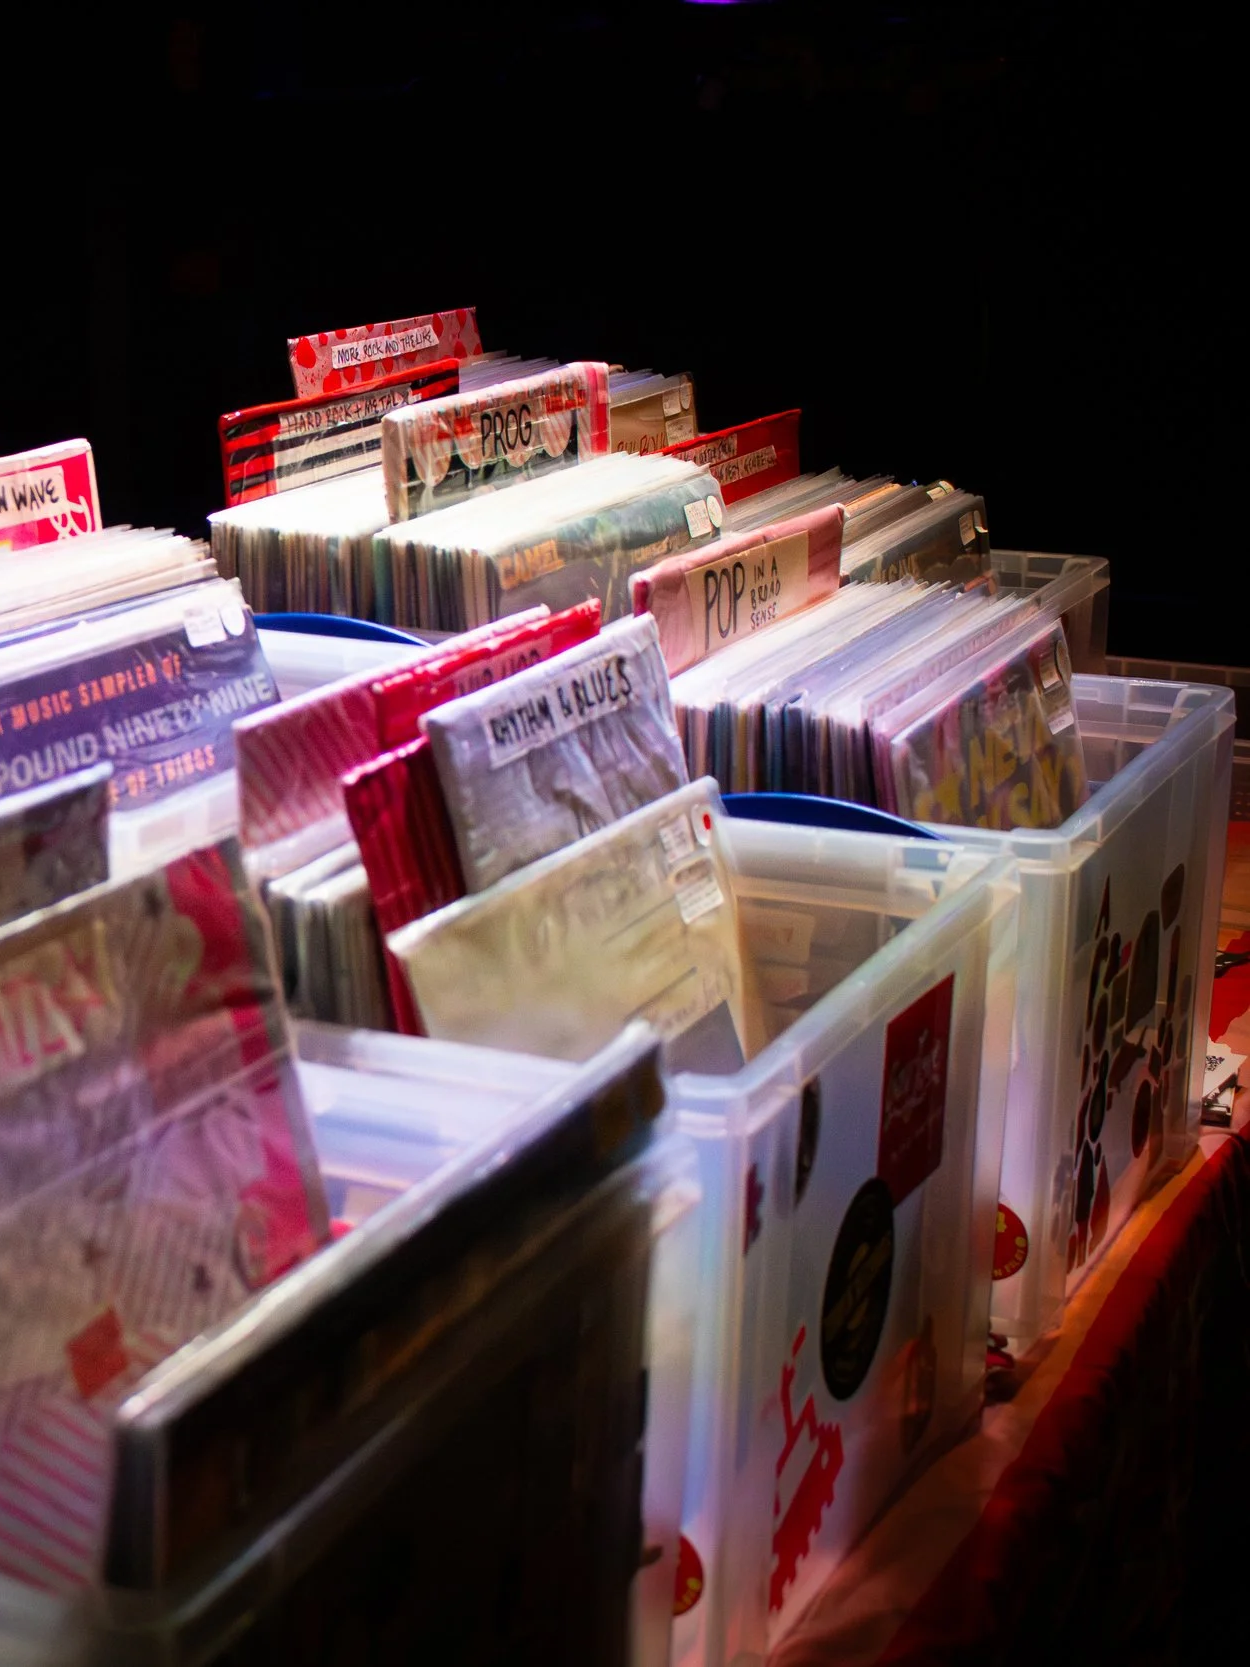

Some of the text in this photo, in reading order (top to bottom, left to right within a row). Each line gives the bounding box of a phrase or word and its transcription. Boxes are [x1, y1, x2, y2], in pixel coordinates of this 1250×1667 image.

[336, 346, 361, 365] MORE
[363, 341, 383, 358] ROCK
[385, 338, 399, 353] AND
[285, 411, 322, 435] HARD
[325, 403, 352, 426] ROCK
[480, 403, 532, 457] PROG
[11, 478, 60, 513] WAVE
[500, 538, 567, 591] CAMEL
[753, 555, 778, 583] IN A
[704, 561, 745, 654] POP
[750, 580, 781, 611] BROAD
[750, 602, 777, 631] SENSE
[9, 689, 73, 730] MUSIC
[77, 661, 158, 708] SAMPLER
[488, 655, 633, 748] RHYTHM & BLUES
